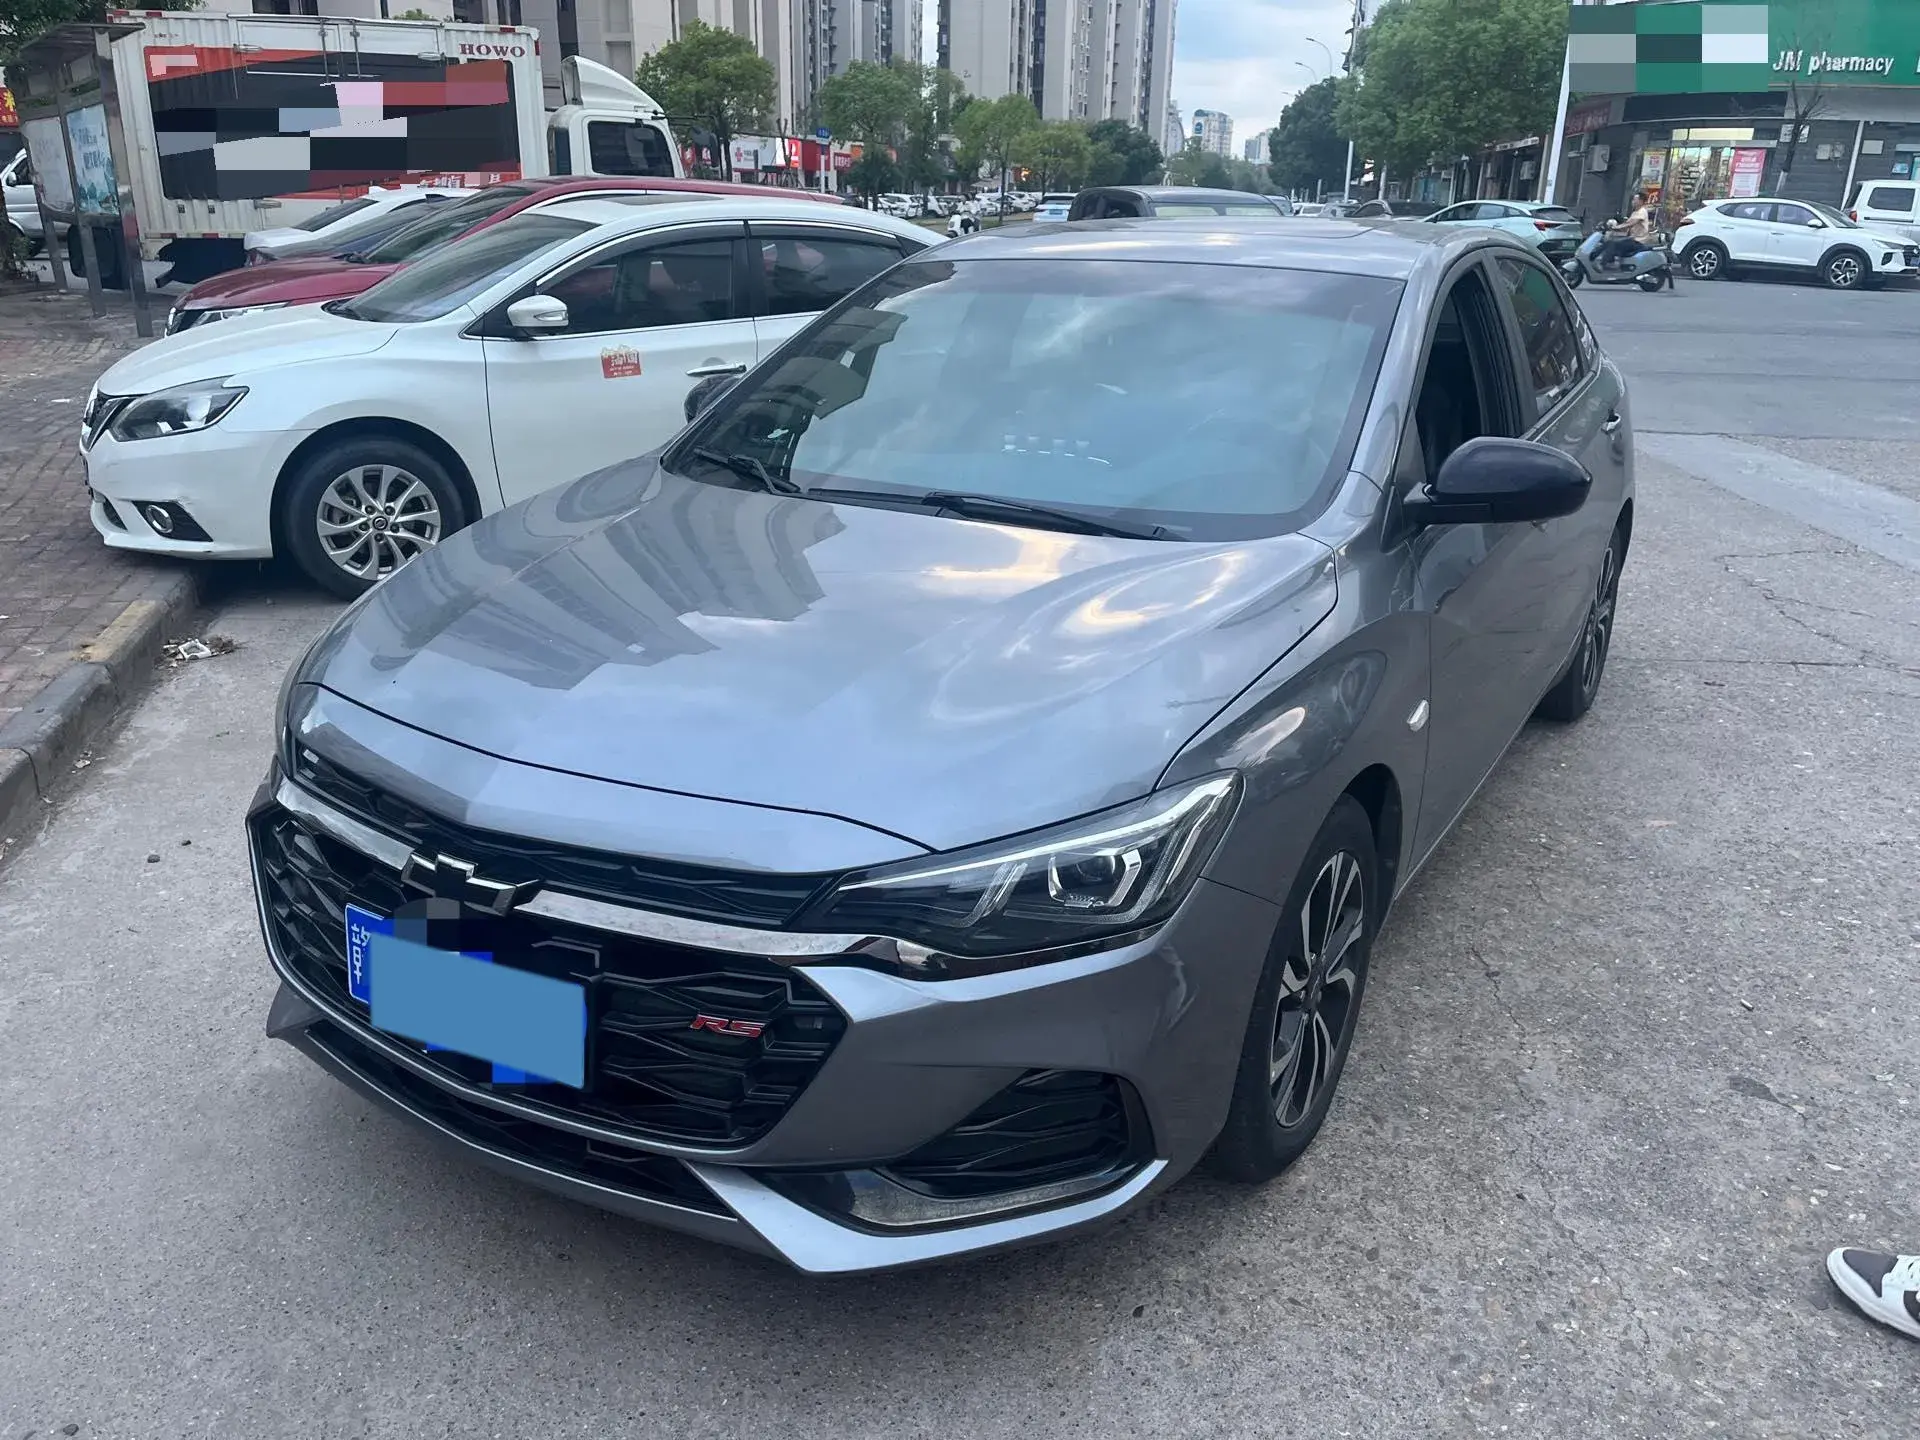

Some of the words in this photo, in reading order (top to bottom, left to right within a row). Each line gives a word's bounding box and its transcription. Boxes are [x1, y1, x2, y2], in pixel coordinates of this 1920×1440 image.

[459, 43, 526, 58] HOWO
[1772, 50, 1803, 71] JM
[1808, 51, 1894, 75] pharmacy
[690, 1014, 767, 1038] RS
